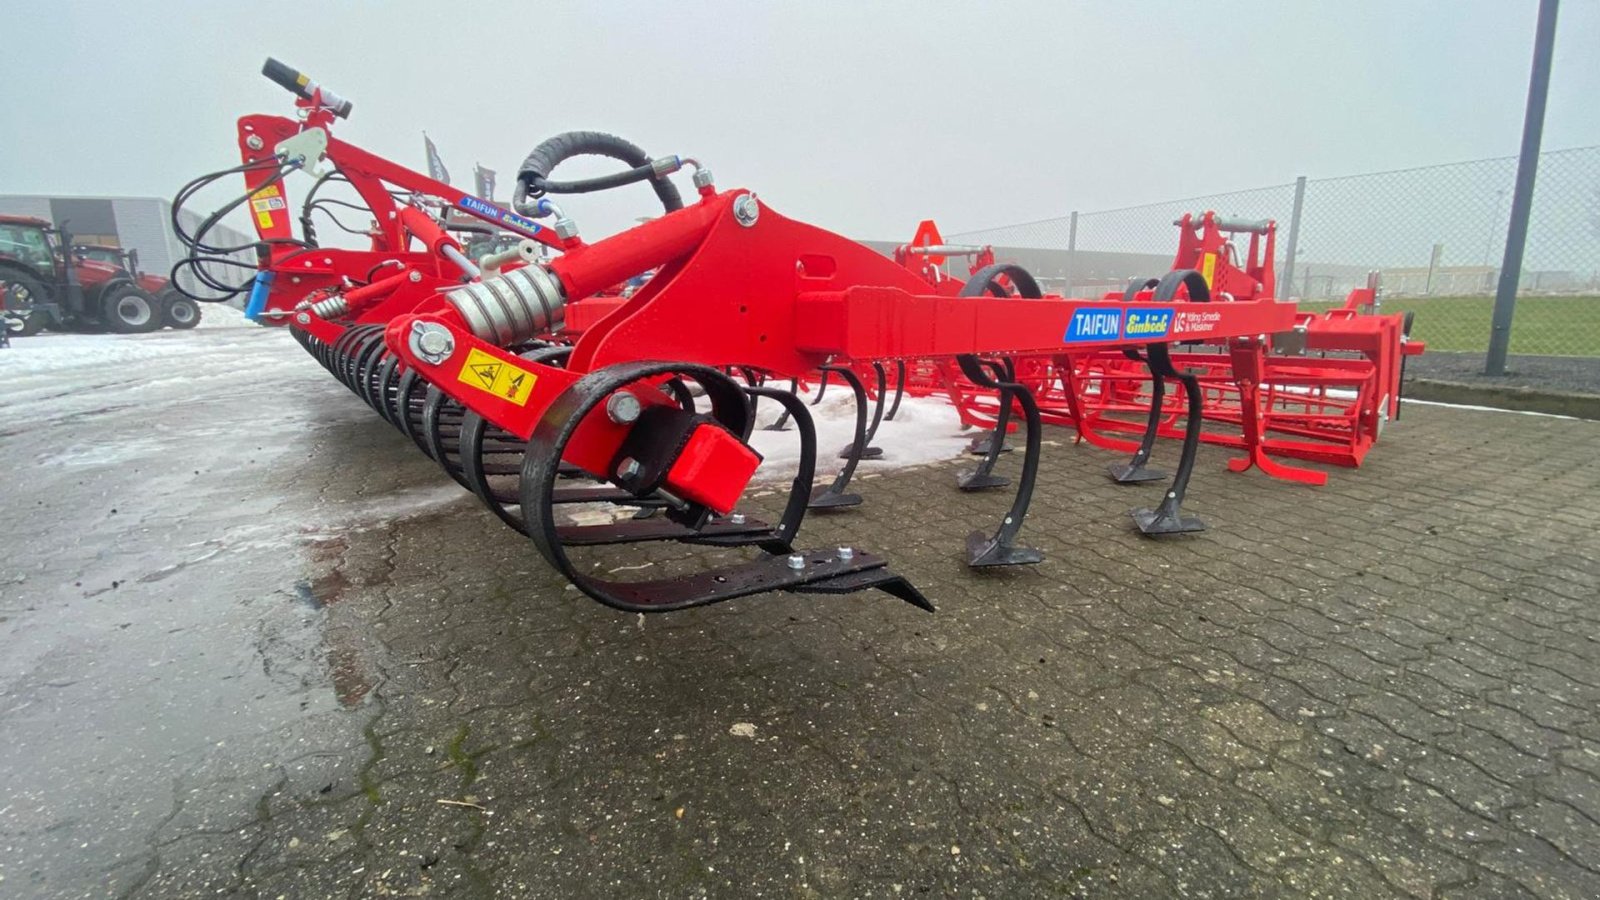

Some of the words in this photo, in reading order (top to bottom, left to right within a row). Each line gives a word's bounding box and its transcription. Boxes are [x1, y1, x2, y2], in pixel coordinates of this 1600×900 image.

[466, 197, 498, 218] TAIFUN
[1075, 314, 1120, 336] TAIFUN
[1126, 314, 1168, 333] Einböck
